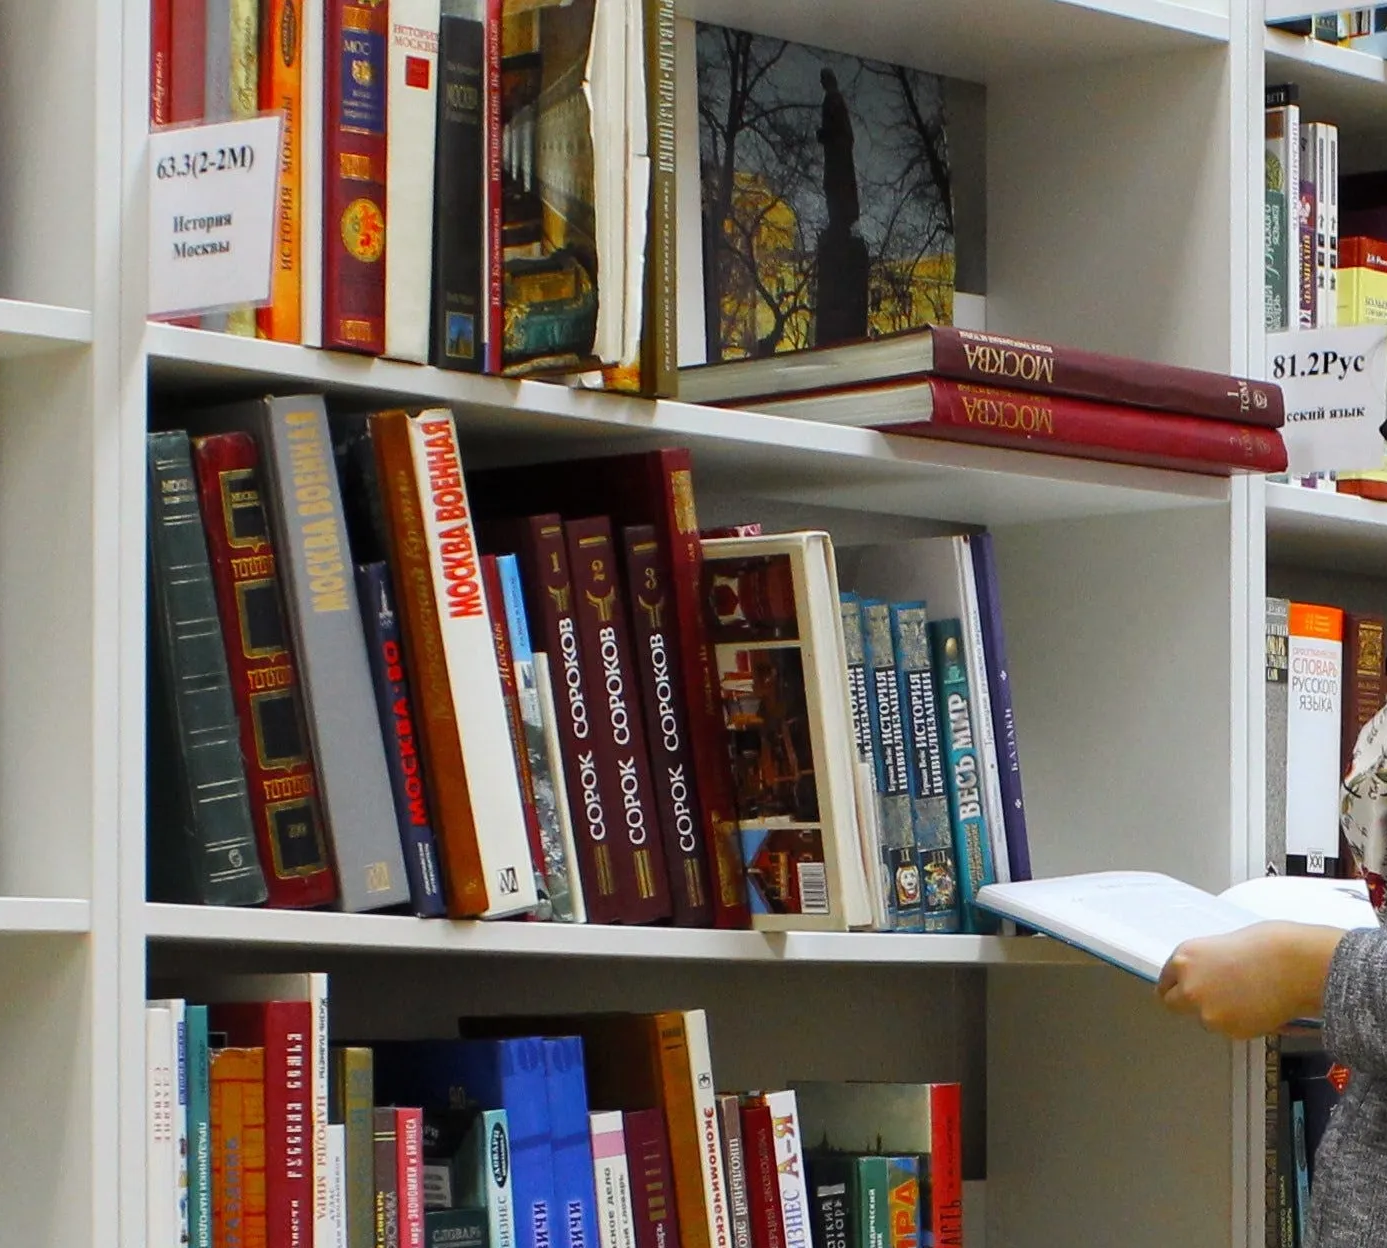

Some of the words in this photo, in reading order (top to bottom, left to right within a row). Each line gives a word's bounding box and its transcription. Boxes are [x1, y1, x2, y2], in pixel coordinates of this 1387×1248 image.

[156, 144, 254, 182] 63.3(2-2М)
[173, 209, 231, 236] История
[173, 238, 229, 261] Москвы
[962, 342, 1054, 383] МОСКВА
[1272, 349, 1365, 383] 81.2Рус
[962, 396, 1054, 433] МОСКВА
[1285, 407, 1325, 422] сский
[1329, 405, 1364, 421] язык
[420, 419, 467, 523] ВОЕННАЯ
[436, 522, 485, 620] МОСКВА
[558, 616, 590, 739] СОРОКОВ
[598, 625, 631, 746] СОРОКОВ
[1292, 657, 1338, 676] СЛОВАРЬ
[1292, 676, 1339, 695] РУССКОГО
[648, 632, 679, 753] СОРОКОВ
[1298, 694, 1333, 712] ЯЗЫКА
[946, 689, 975, 751] МИР
[577, 750, 605, 841] СОРОК
[617, 757, 645, 846] СОРОК
[667, 764, 694, 852] СОРОК
[952, 754, 982, 821] ВЕСЬ
